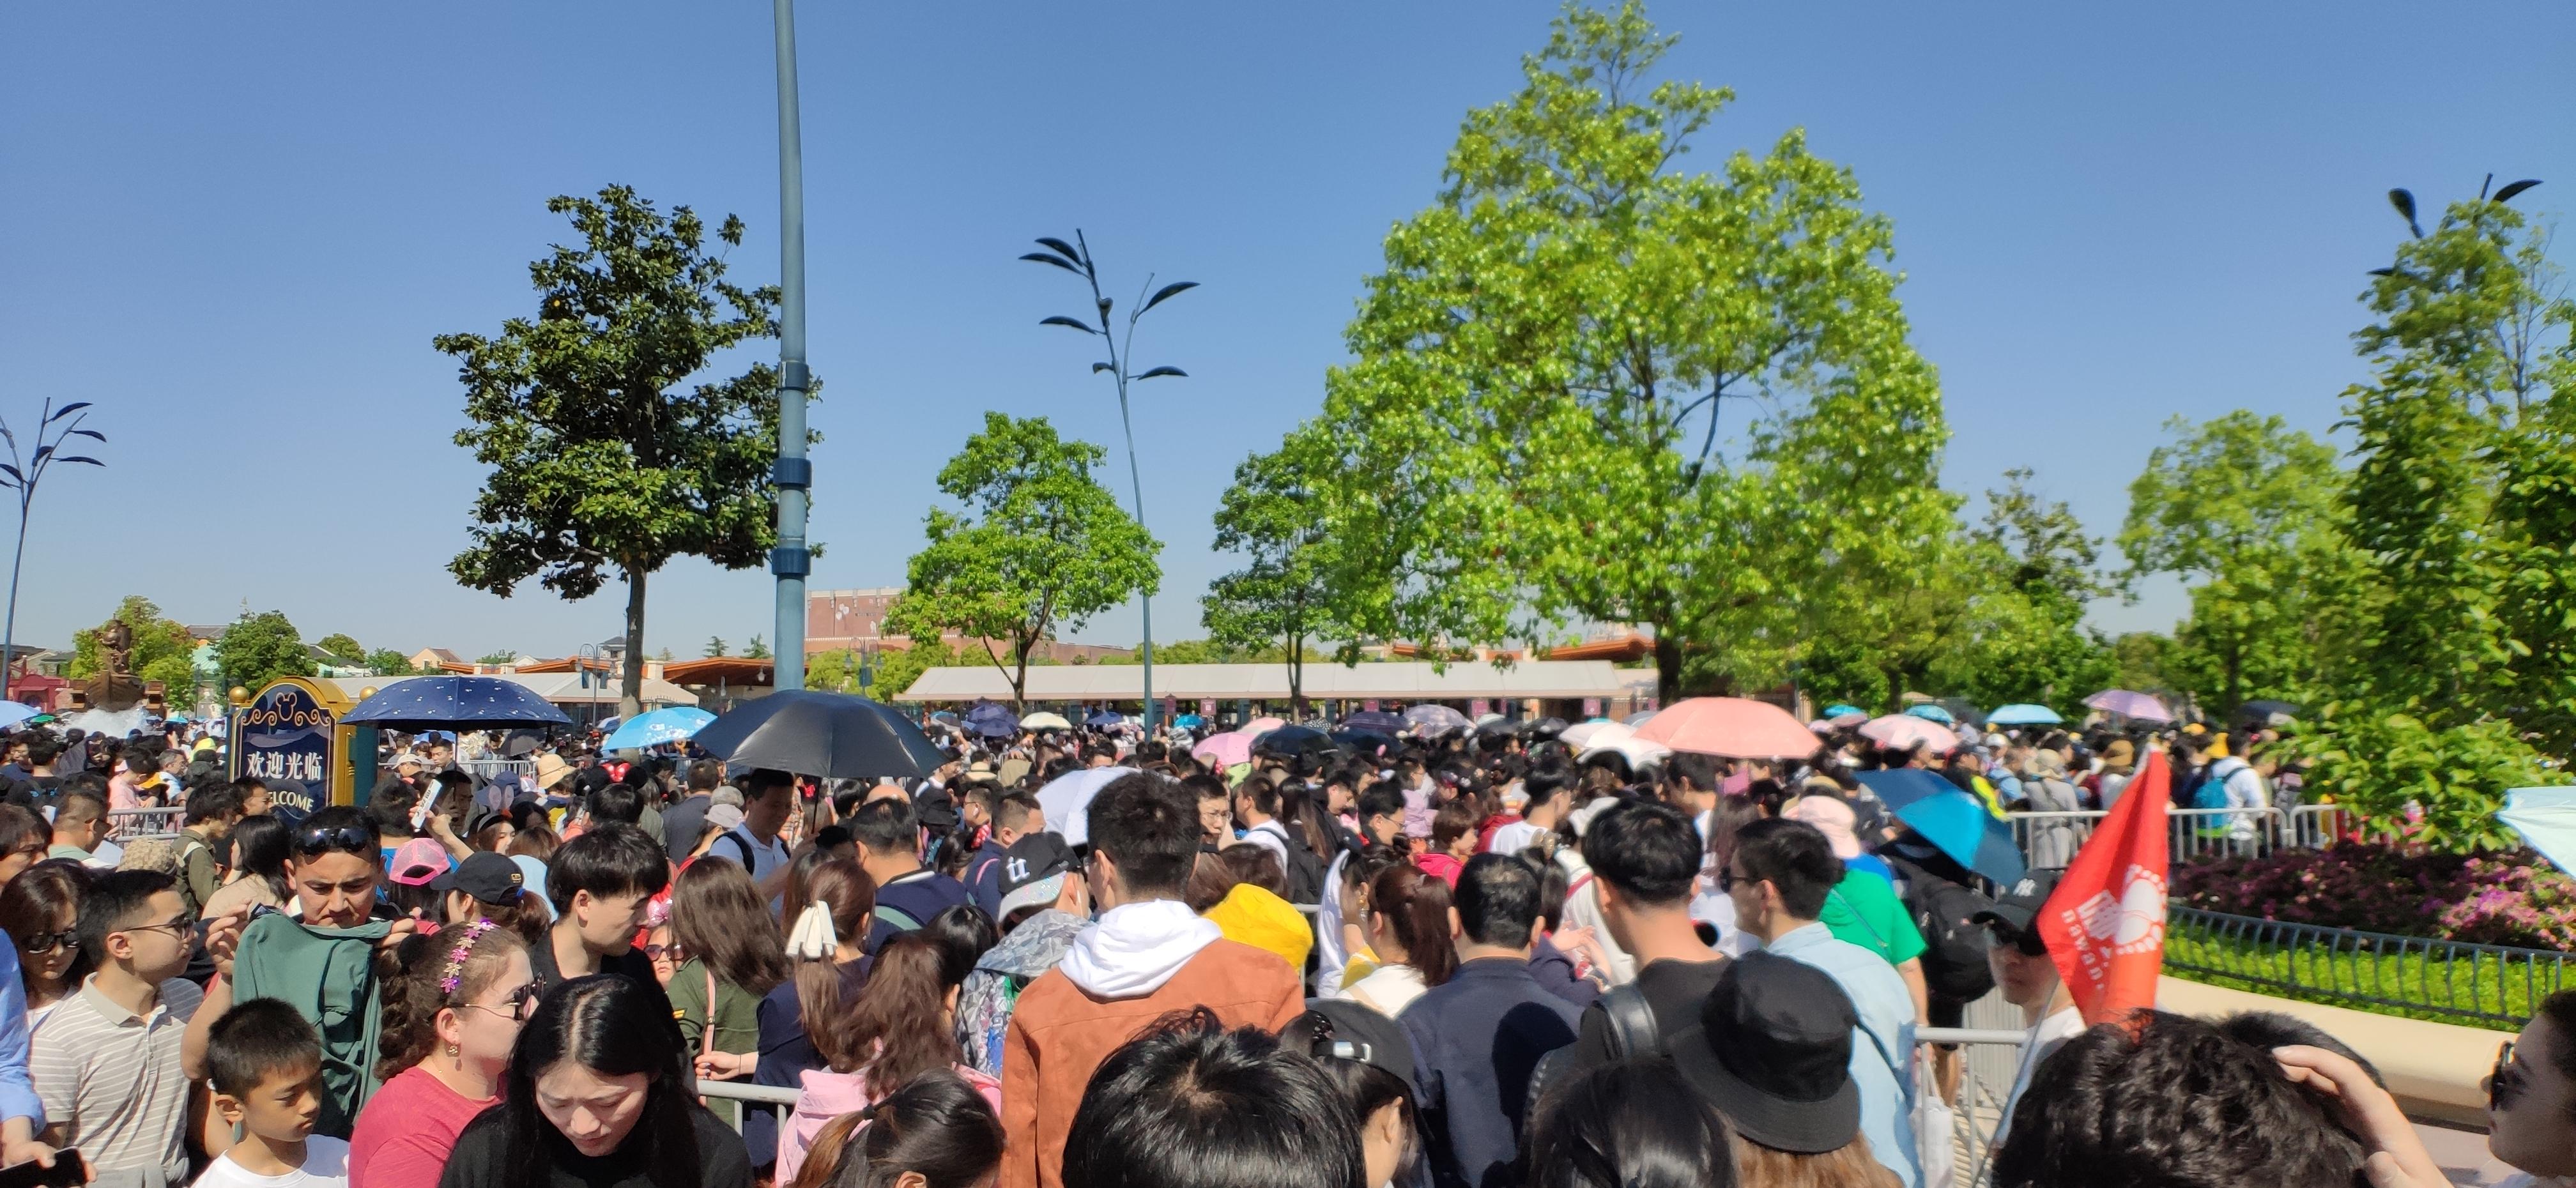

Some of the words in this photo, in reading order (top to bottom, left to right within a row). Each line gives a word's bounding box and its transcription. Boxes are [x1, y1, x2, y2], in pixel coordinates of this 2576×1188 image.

[246, 750, 323, 781] 欢迎光临
[268, 791, 314, 813] LCOME
